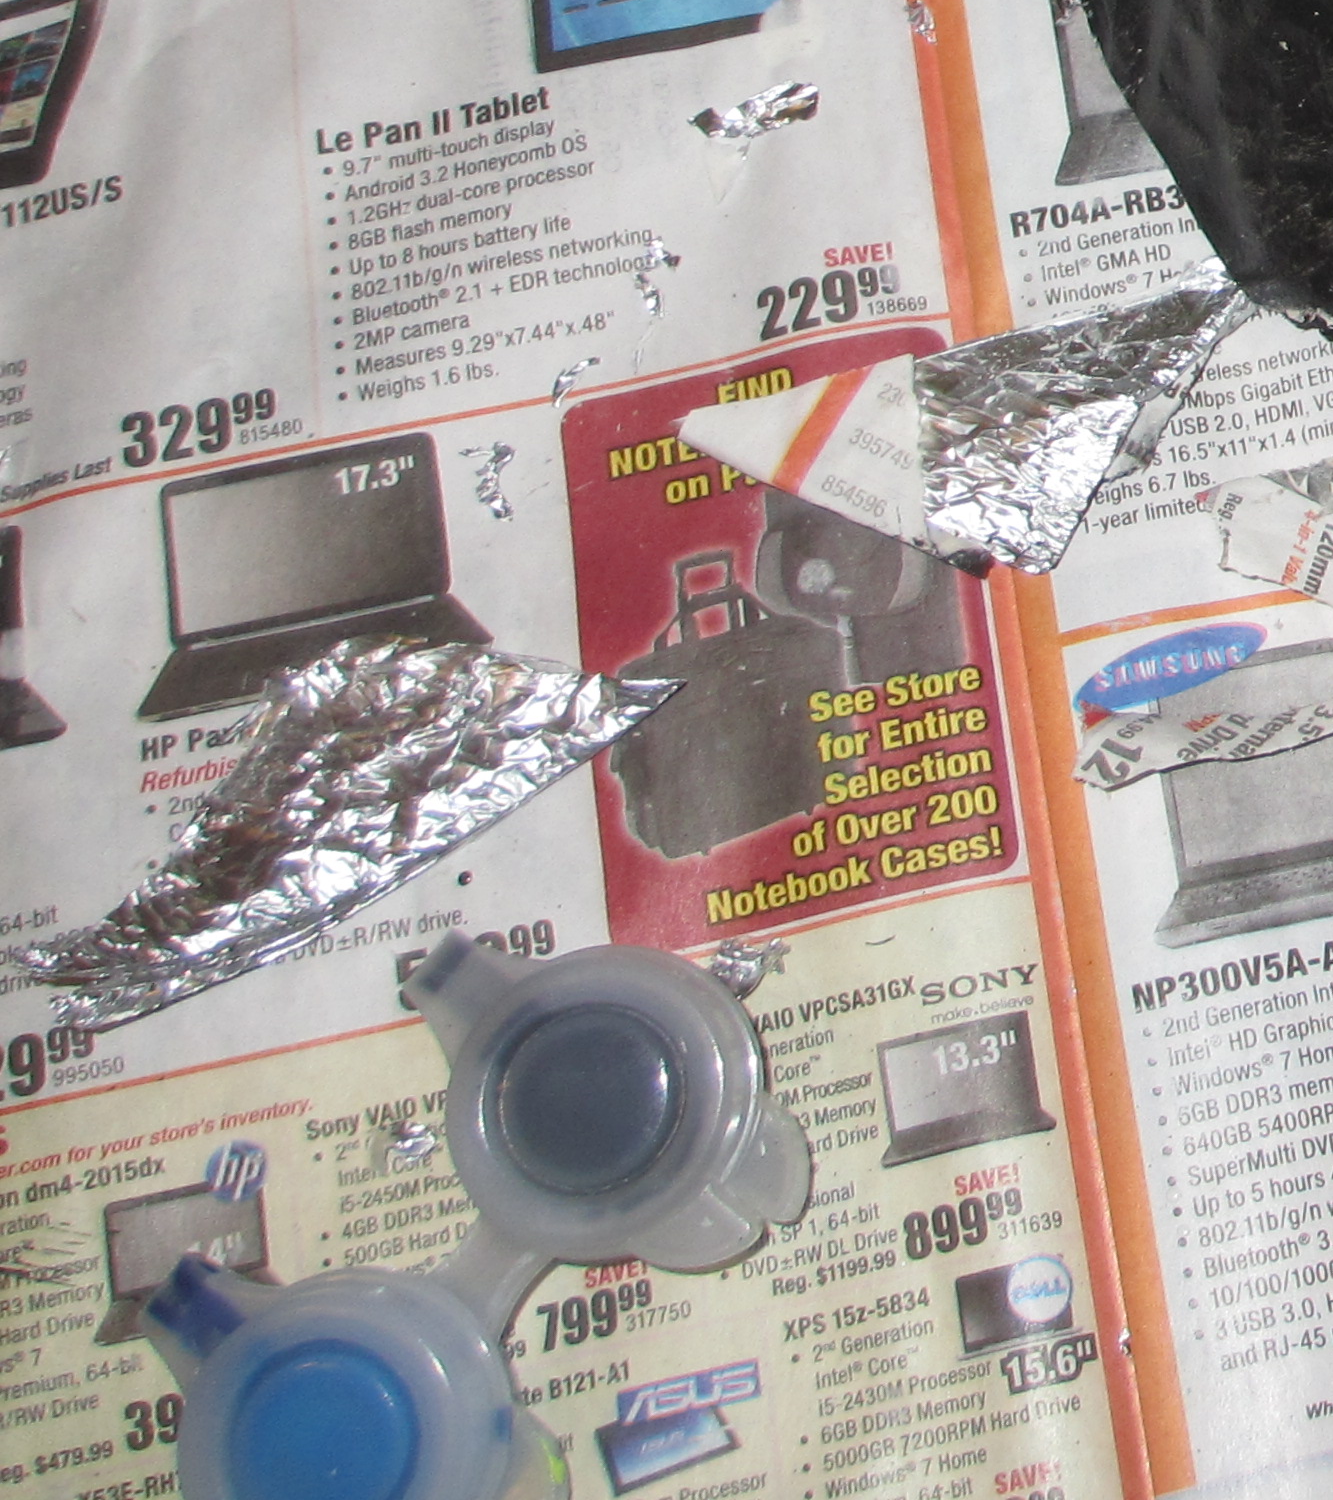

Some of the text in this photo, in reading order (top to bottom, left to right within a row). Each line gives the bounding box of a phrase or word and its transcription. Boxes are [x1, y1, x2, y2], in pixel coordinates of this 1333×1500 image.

[316, 87, 548, 154] Le Pan II Tablet
[823, 241, 894, 269] SAVE!
[354, 315, 469, 350] 2MP camera
[357, 364, 498, 401] Weighs 1.6 lbs.
[808, 662, 981, 723] See Store
[1094, 641, 1245, 693] SAMSUNG
[817, 705, 987, 762] for Entire
[822, 748, 992, 807] Selection
[791, 785, 997, 858] of Over 200
[705, 826, 1004, 926] Notebook Cases!
[920, 963, 1037, 1008] SONY
[952, 1163, 1021, 1197] SAVE!
[1193, 1195, 1219, 1217] Up
[1225, 1190, 1245, 1208] to
[1252, 1181, 1264, 1202] 5
[1270, 1172, 1325, 1197] hours
[781, 1287, 932, 1343] XPS 15z-5834
[618, 1360, 762, 1425] ASUS
